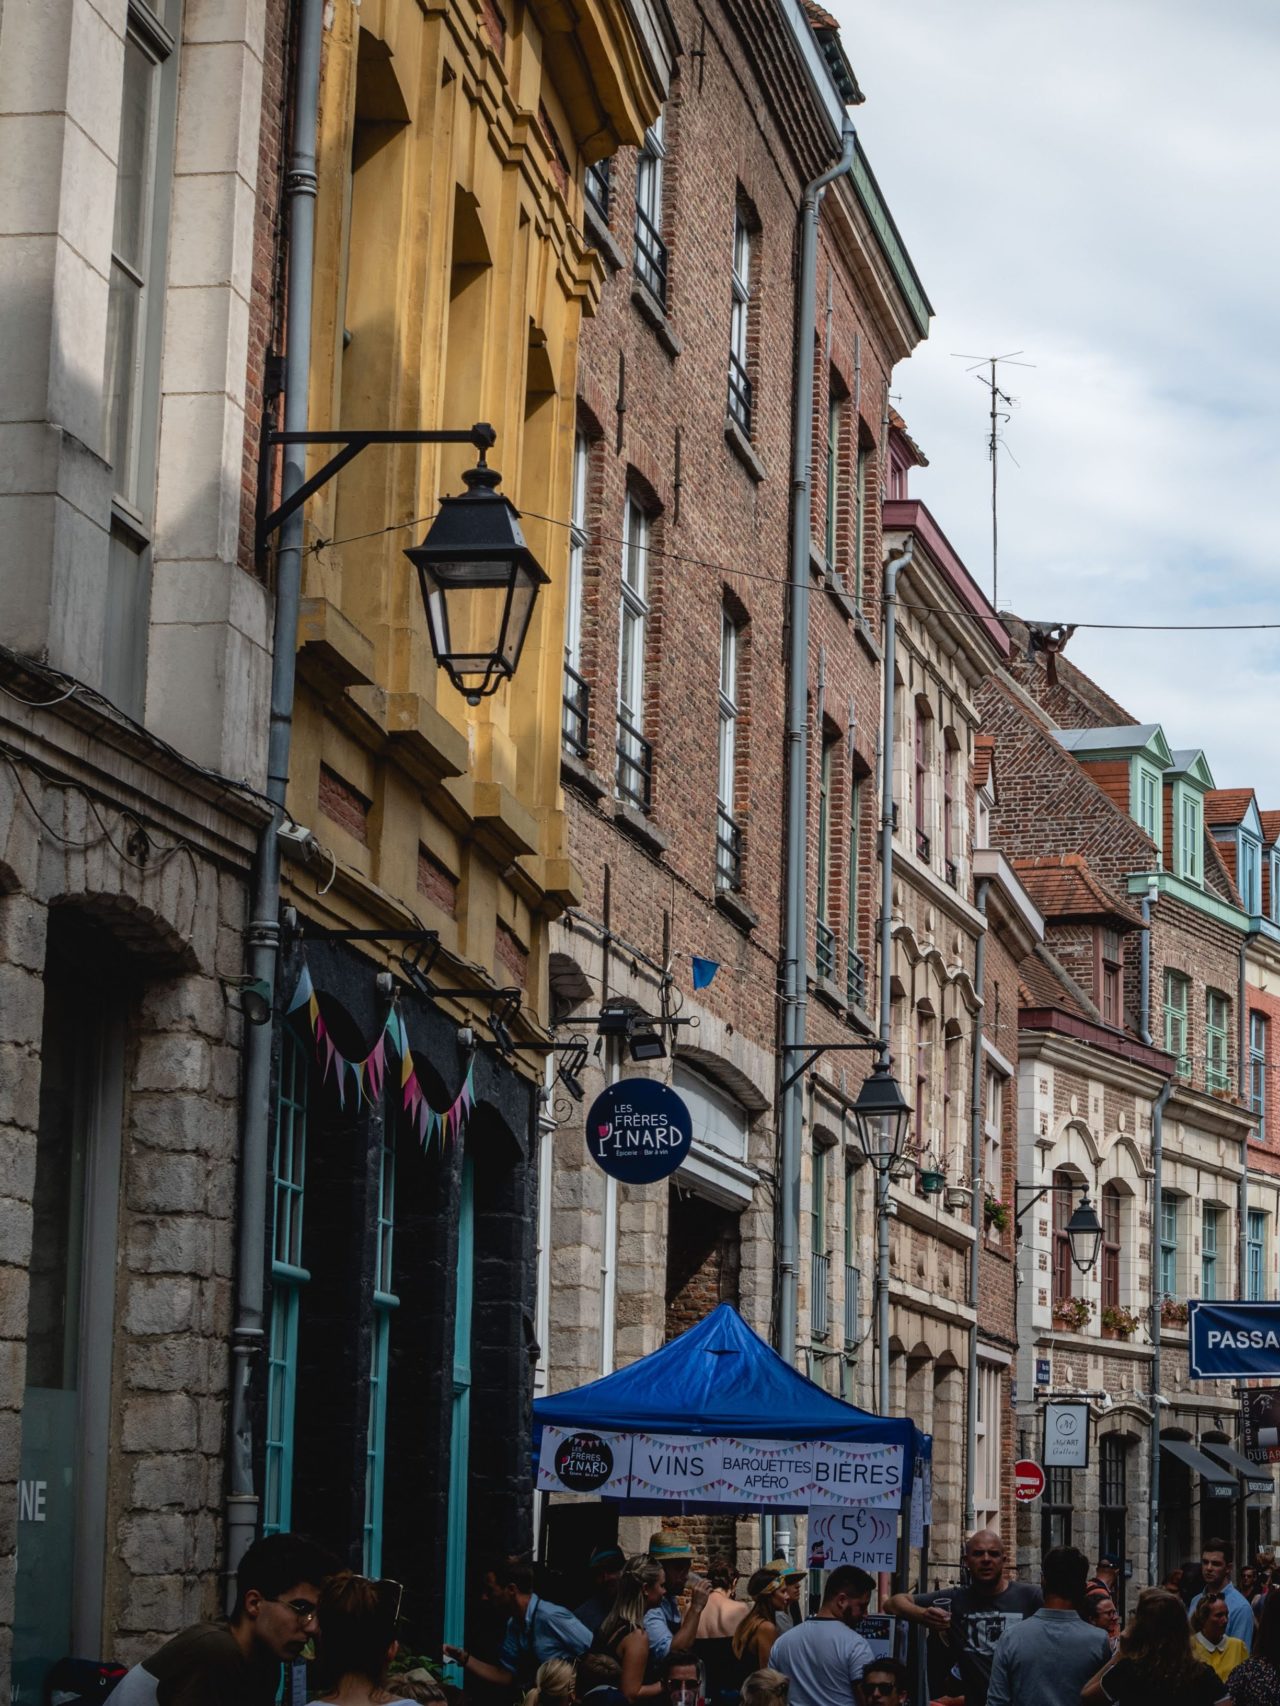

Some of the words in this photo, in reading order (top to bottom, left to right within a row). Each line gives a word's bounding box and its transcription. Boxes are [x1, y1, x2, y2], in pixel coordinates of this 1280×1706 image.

[614, 1104, 632, 1114] LES
[615, 1112, 668, 1127] FRÈRES
[1243, 1391, 1252, 1446] SHOWROOM
[648, 1455, 705, 1477] VINS
[723, 1457, 812, 1474] BARQUETTES
[816, 1461, 900, 1485] BIÈRES
[744, 1473, 789, 1490] APÉRO
[842, 1508, 867, 1546] 5€
[830, 1551, 848, 1563] LA
[853, 1551, 893, 1565] PINTE
